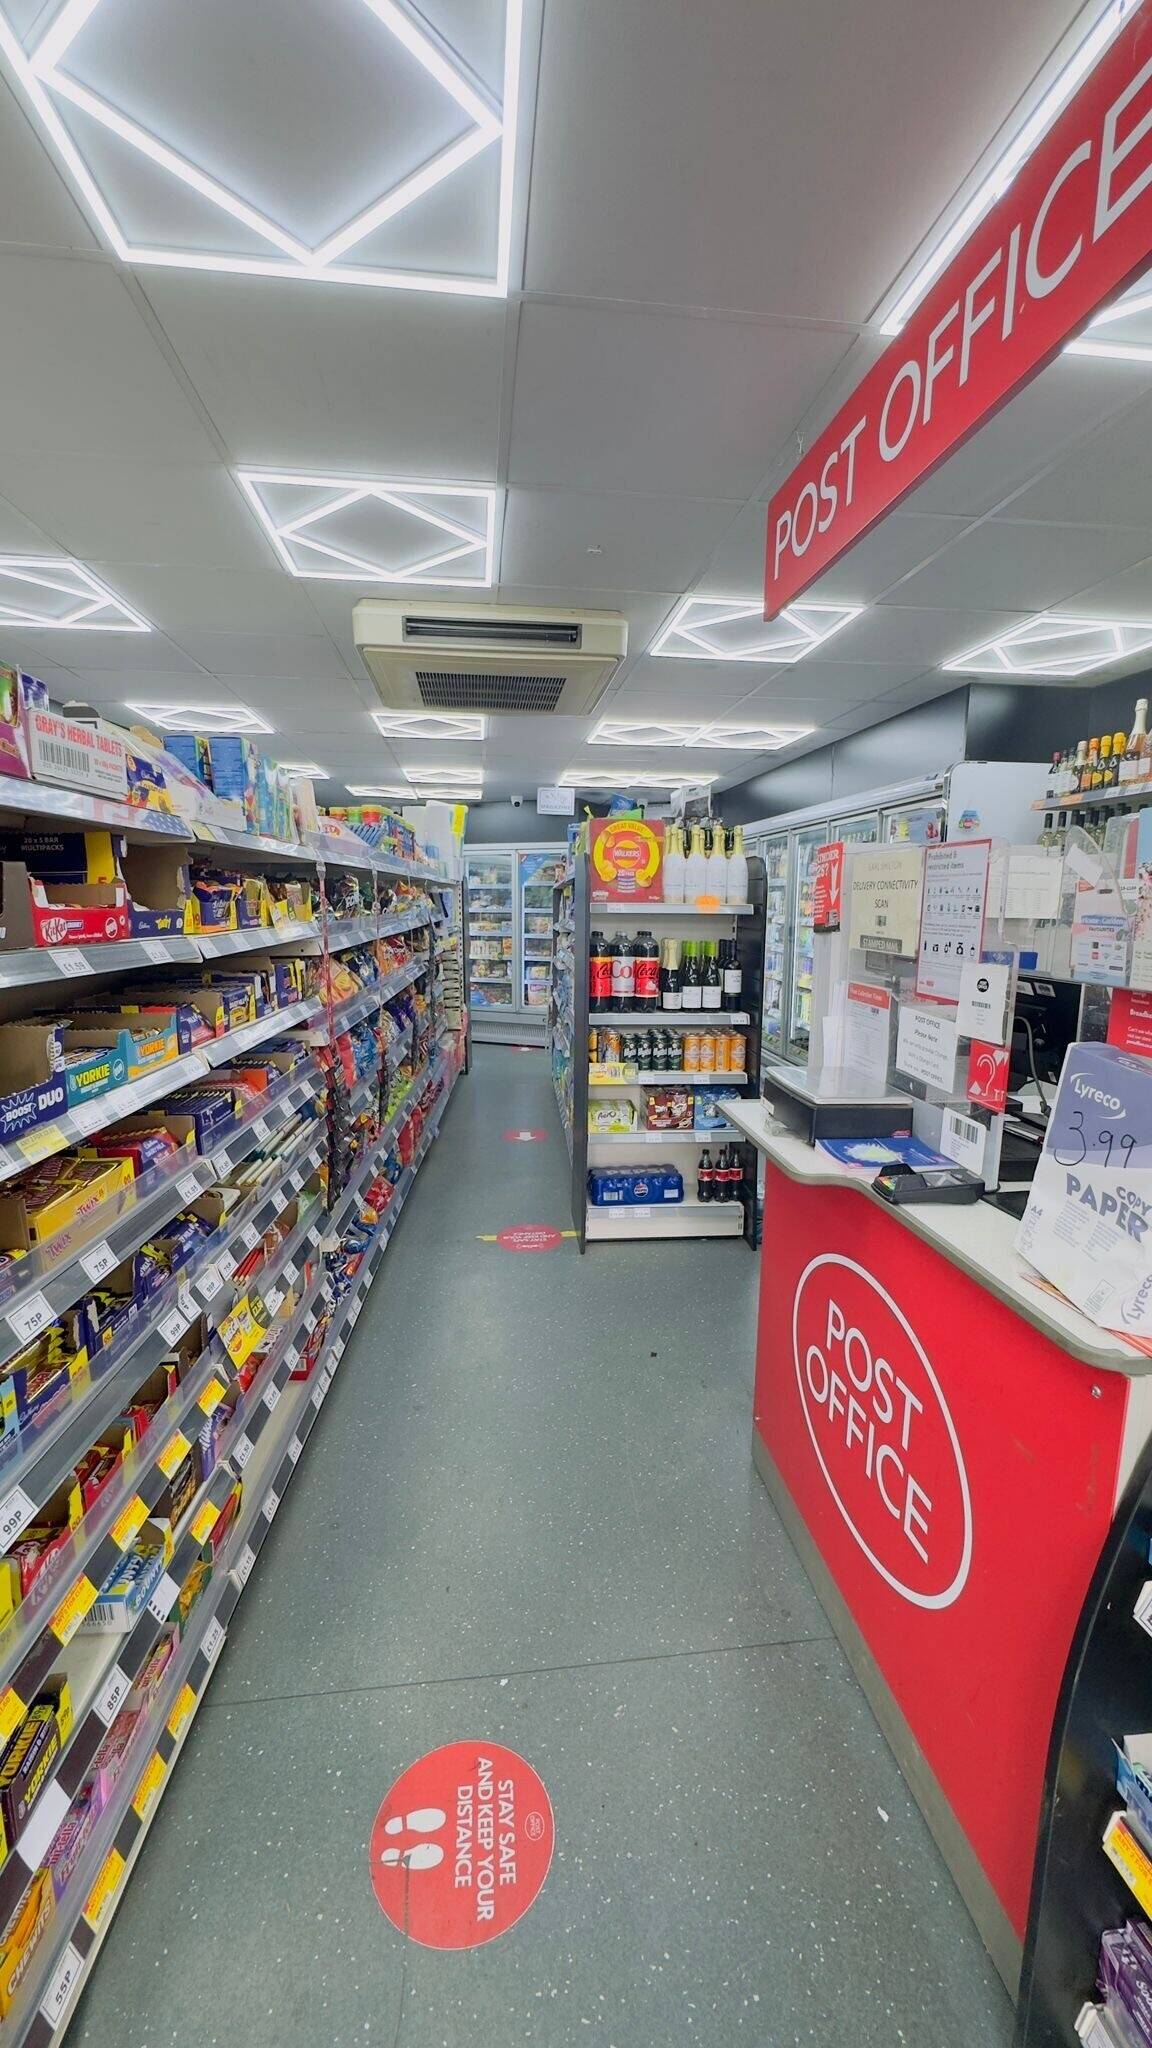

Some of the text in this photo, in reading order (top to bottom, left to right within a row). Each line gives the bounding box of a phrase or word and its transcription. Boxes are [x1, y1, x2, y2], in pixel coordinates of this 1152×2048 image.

[774, 57, 1152, 580] POST OFFICE
[35, 714, 123, 757] GRAY'S HERBAL TABLETS
[852, 879, 919, 891] DELIVERY CONNECTIVITY
[874, 899, 889, 909] SCAN
[75, 1063, 111, 1088] YORKIE
[38, 1087, 64, 1111] DUO
[1074, 1078, 1121, 1110] Lyreco
[5, 1102, 32, 1121] BOOST
[1054, 1111, 1138, 1169] 3.99
[1031, 1205, 1044, 1217] A4
[1066, 1172, 1149, 1243] PAPER
[1116, 1186, 1152, 1217] COPY
[94, 1258, 109, 1273] 75P
[24, 1312, 43, 1332] 75P
[170, 1323, 181, 1337] 99P
[826, 1298, 924, 1451] POST
[805, 1345, 933, 1566] OFFICE
[2, 1509, 24, 1536] 99P
[107, 1686, 121, 1711] 85P
[24, 1733, 59, 1804] YORKIE
[455, 1785, 473, 1889] DISTANCE
[476, 1757, 495, 1922] AND KEEP YOUR
[498, 1779, 517, 1886] STAY SAFE
[7, 1896, 52, 1996] CHEWITS
[55, 1969, 72, 2006] 55P
